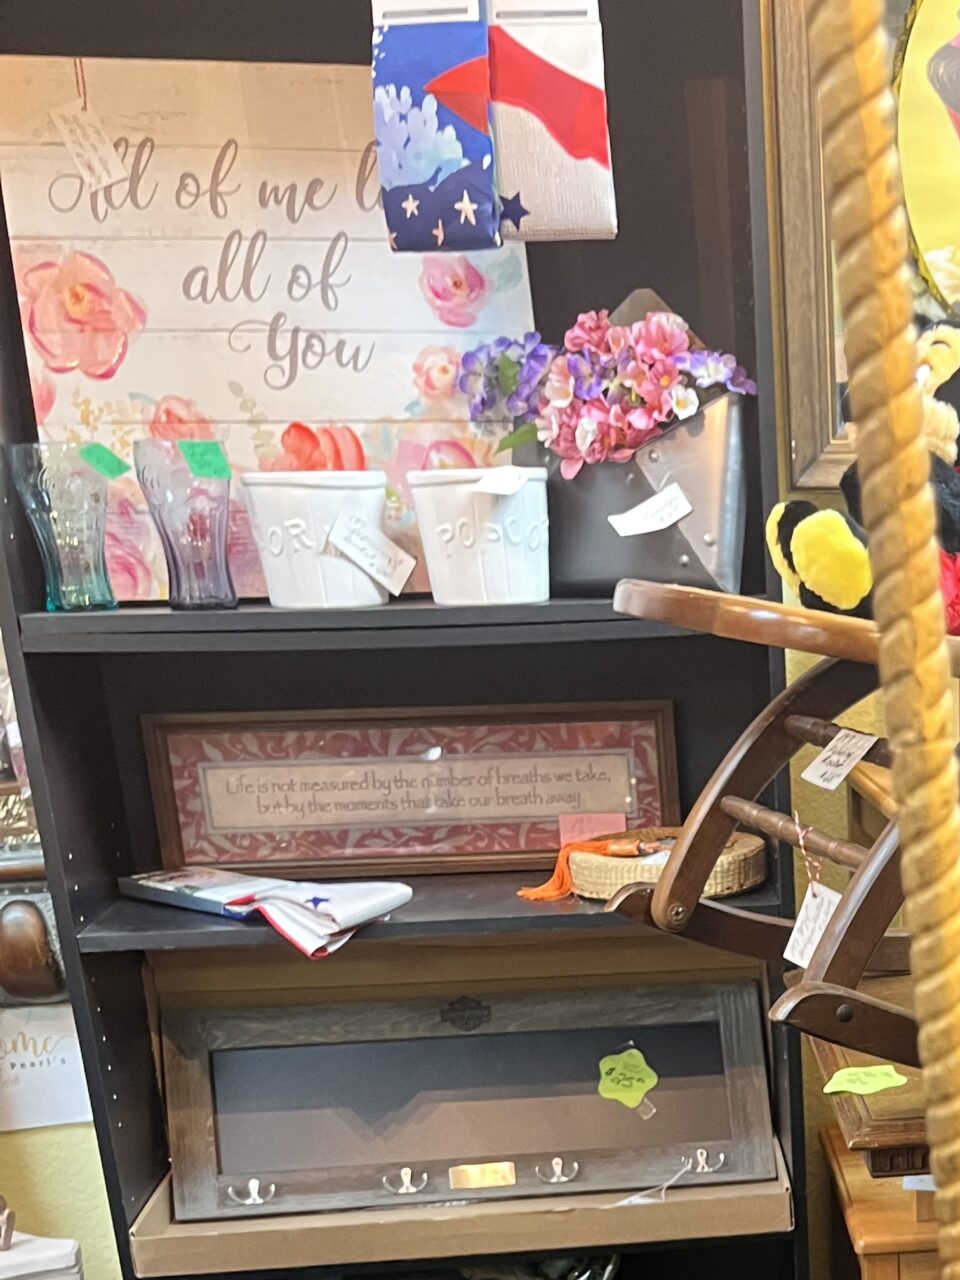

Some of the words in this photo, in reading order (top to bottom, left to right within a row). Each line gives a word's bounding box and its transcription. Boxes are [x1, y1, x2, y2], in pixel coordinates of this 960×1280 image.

[174, 138, 242, 219] of
[257, 176, 338, 225] me
[182, 229, 272, 305] all
[286, 230, 351, 312] of
[225, 775, 255, 795] Life
[257, 776, 270, 794] is
[271, 778, 296, 794] not
[300, 771, 369, 793] measured
[371, 770, 392, 797] by
[393, 769, 418, 789] the
[421, 767, 475, 789] number
[477, 766, 495, 787] of
[495, 764, 552, 786] breaths
[553, 769, 573, 784] we
[256, 794, 281, 816] but
[284, 793, 305, 819] by
[306, 793, 332, 813] the
[334, 797, 398, 813] moments
[400, 790, 432, 811] that
[434, 789, 465, 810] take
[468, 795, 491, 809] our
[495, 785, 543, 807] breath
